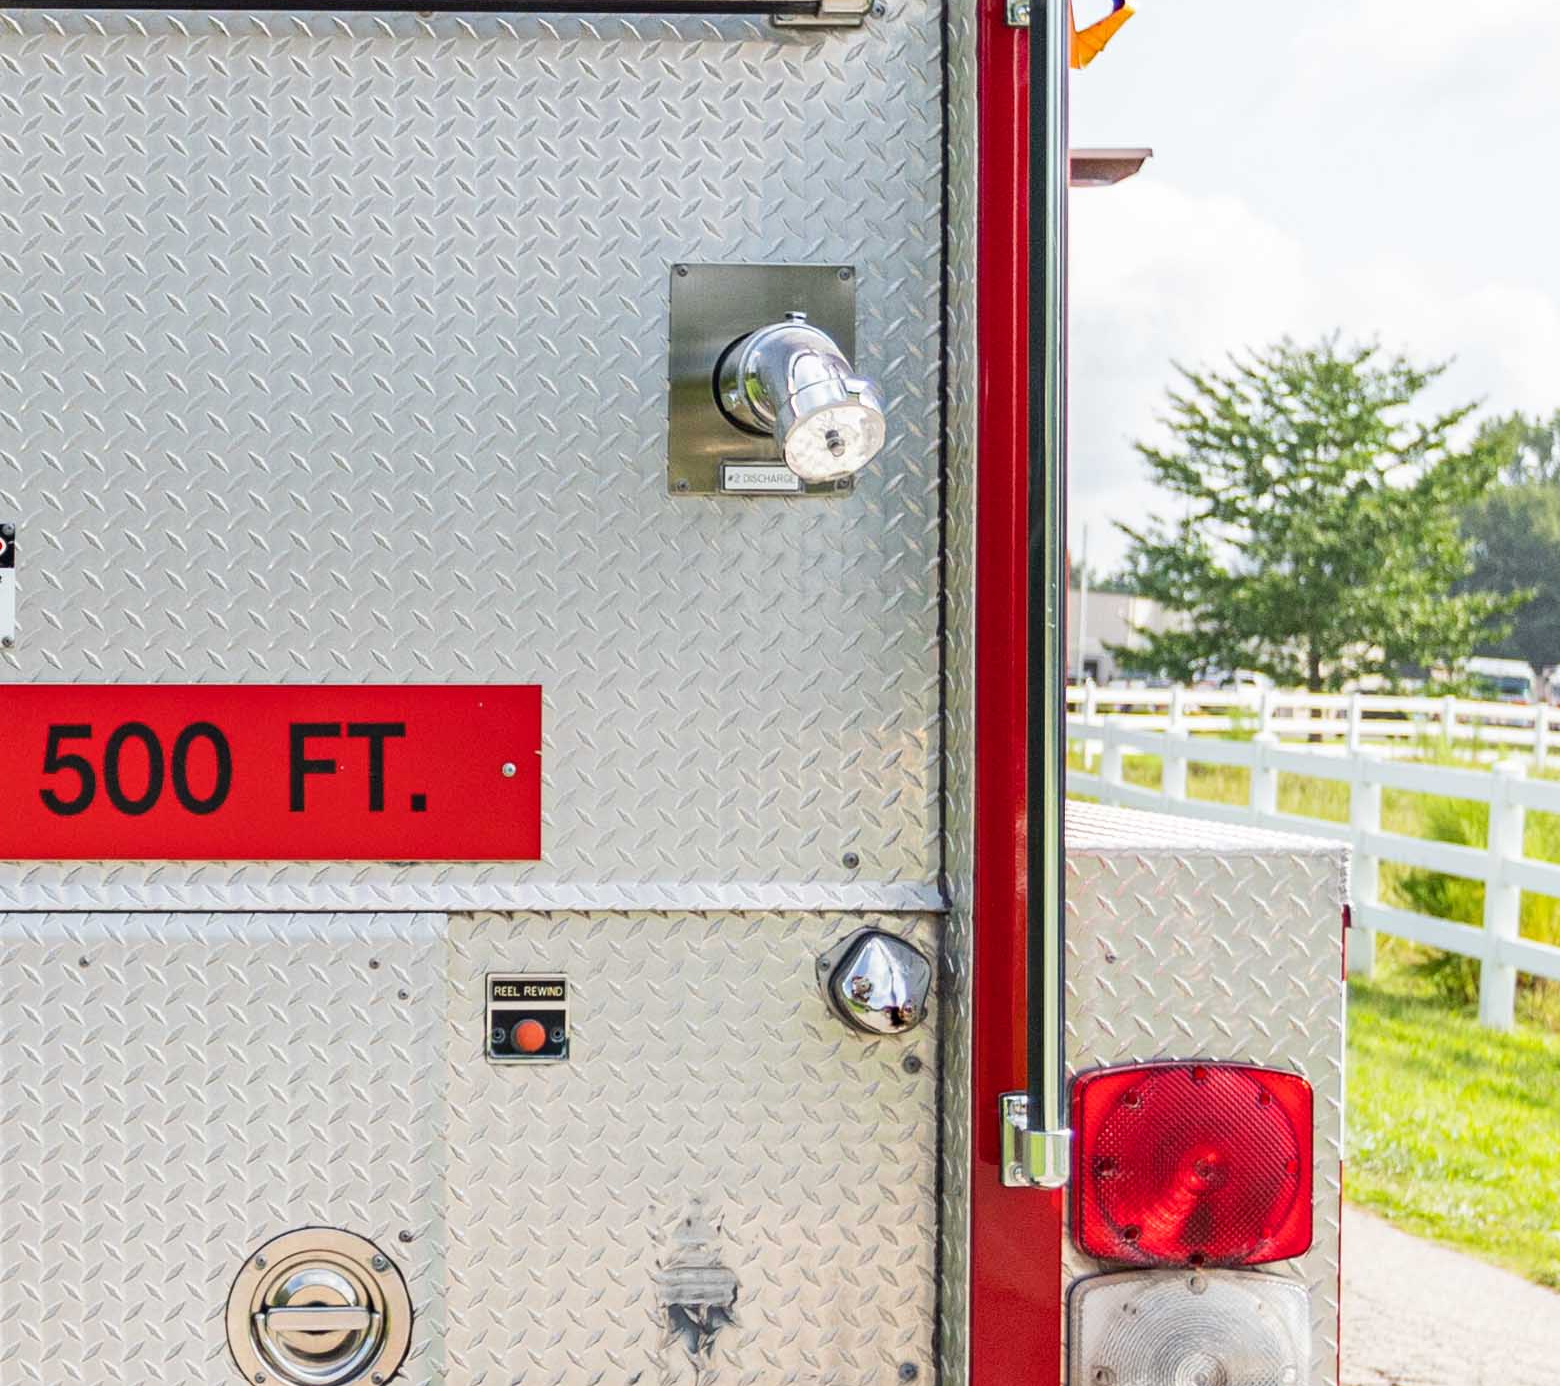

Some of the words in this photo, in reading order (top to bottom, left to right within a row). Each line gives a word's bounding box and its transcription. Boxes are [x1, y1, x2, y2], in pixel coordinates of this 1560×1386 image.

[37, 721, 233, 817] 500
[287, 721, 427, 813] FT.
[494, 986, 520, 997] REEL
[523, 986, 563, 997] REWIND
